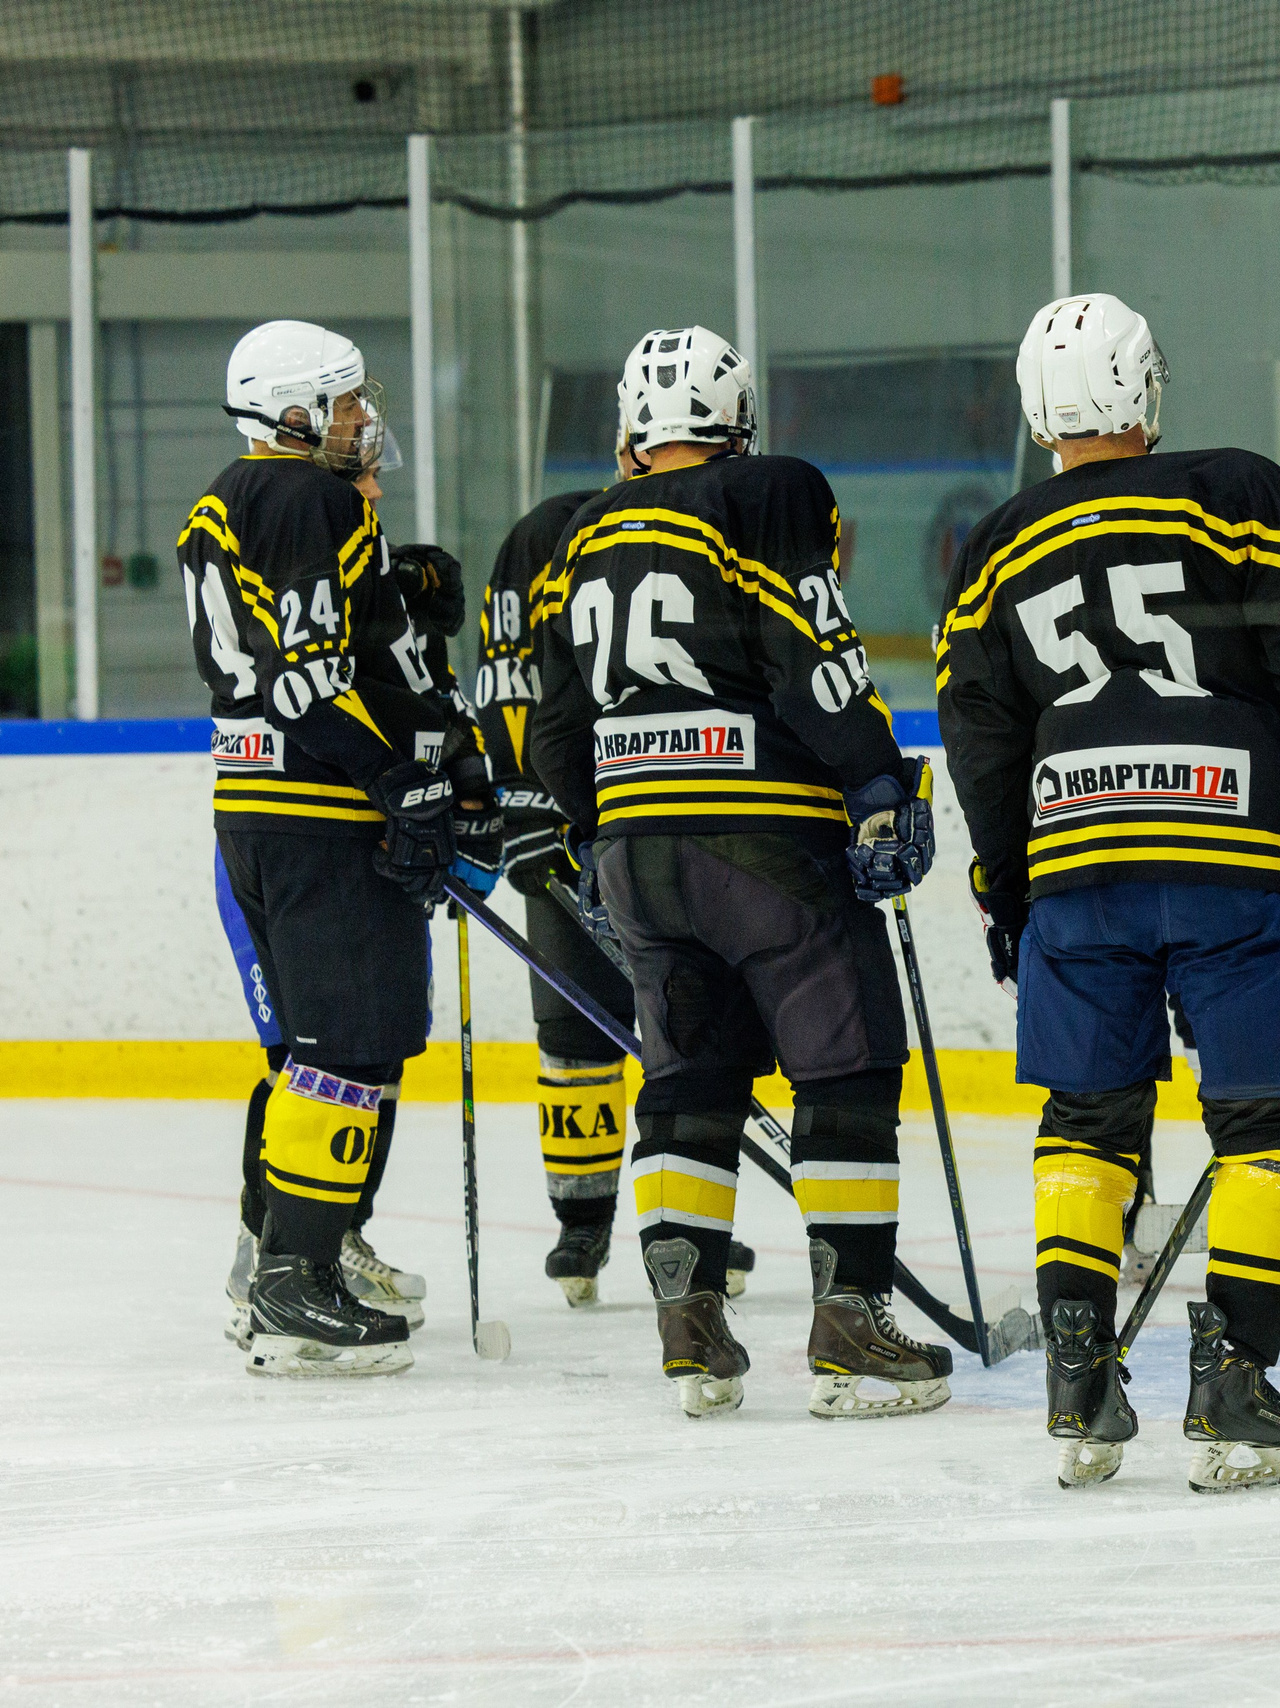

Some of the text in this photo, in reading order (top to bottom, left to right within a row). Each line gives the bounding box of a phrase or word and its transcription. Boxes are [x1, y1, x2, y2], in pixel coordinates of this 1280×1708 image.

[280, 578, 340, 649] 24
[493, 589, 521, 642] 18
[570, 571, 716, 713] 26
[1015, 561, 1214, 707] 55
[305, 1310, 349, 1328] CCM
[869, 1344, 897, 1359] BAUER
